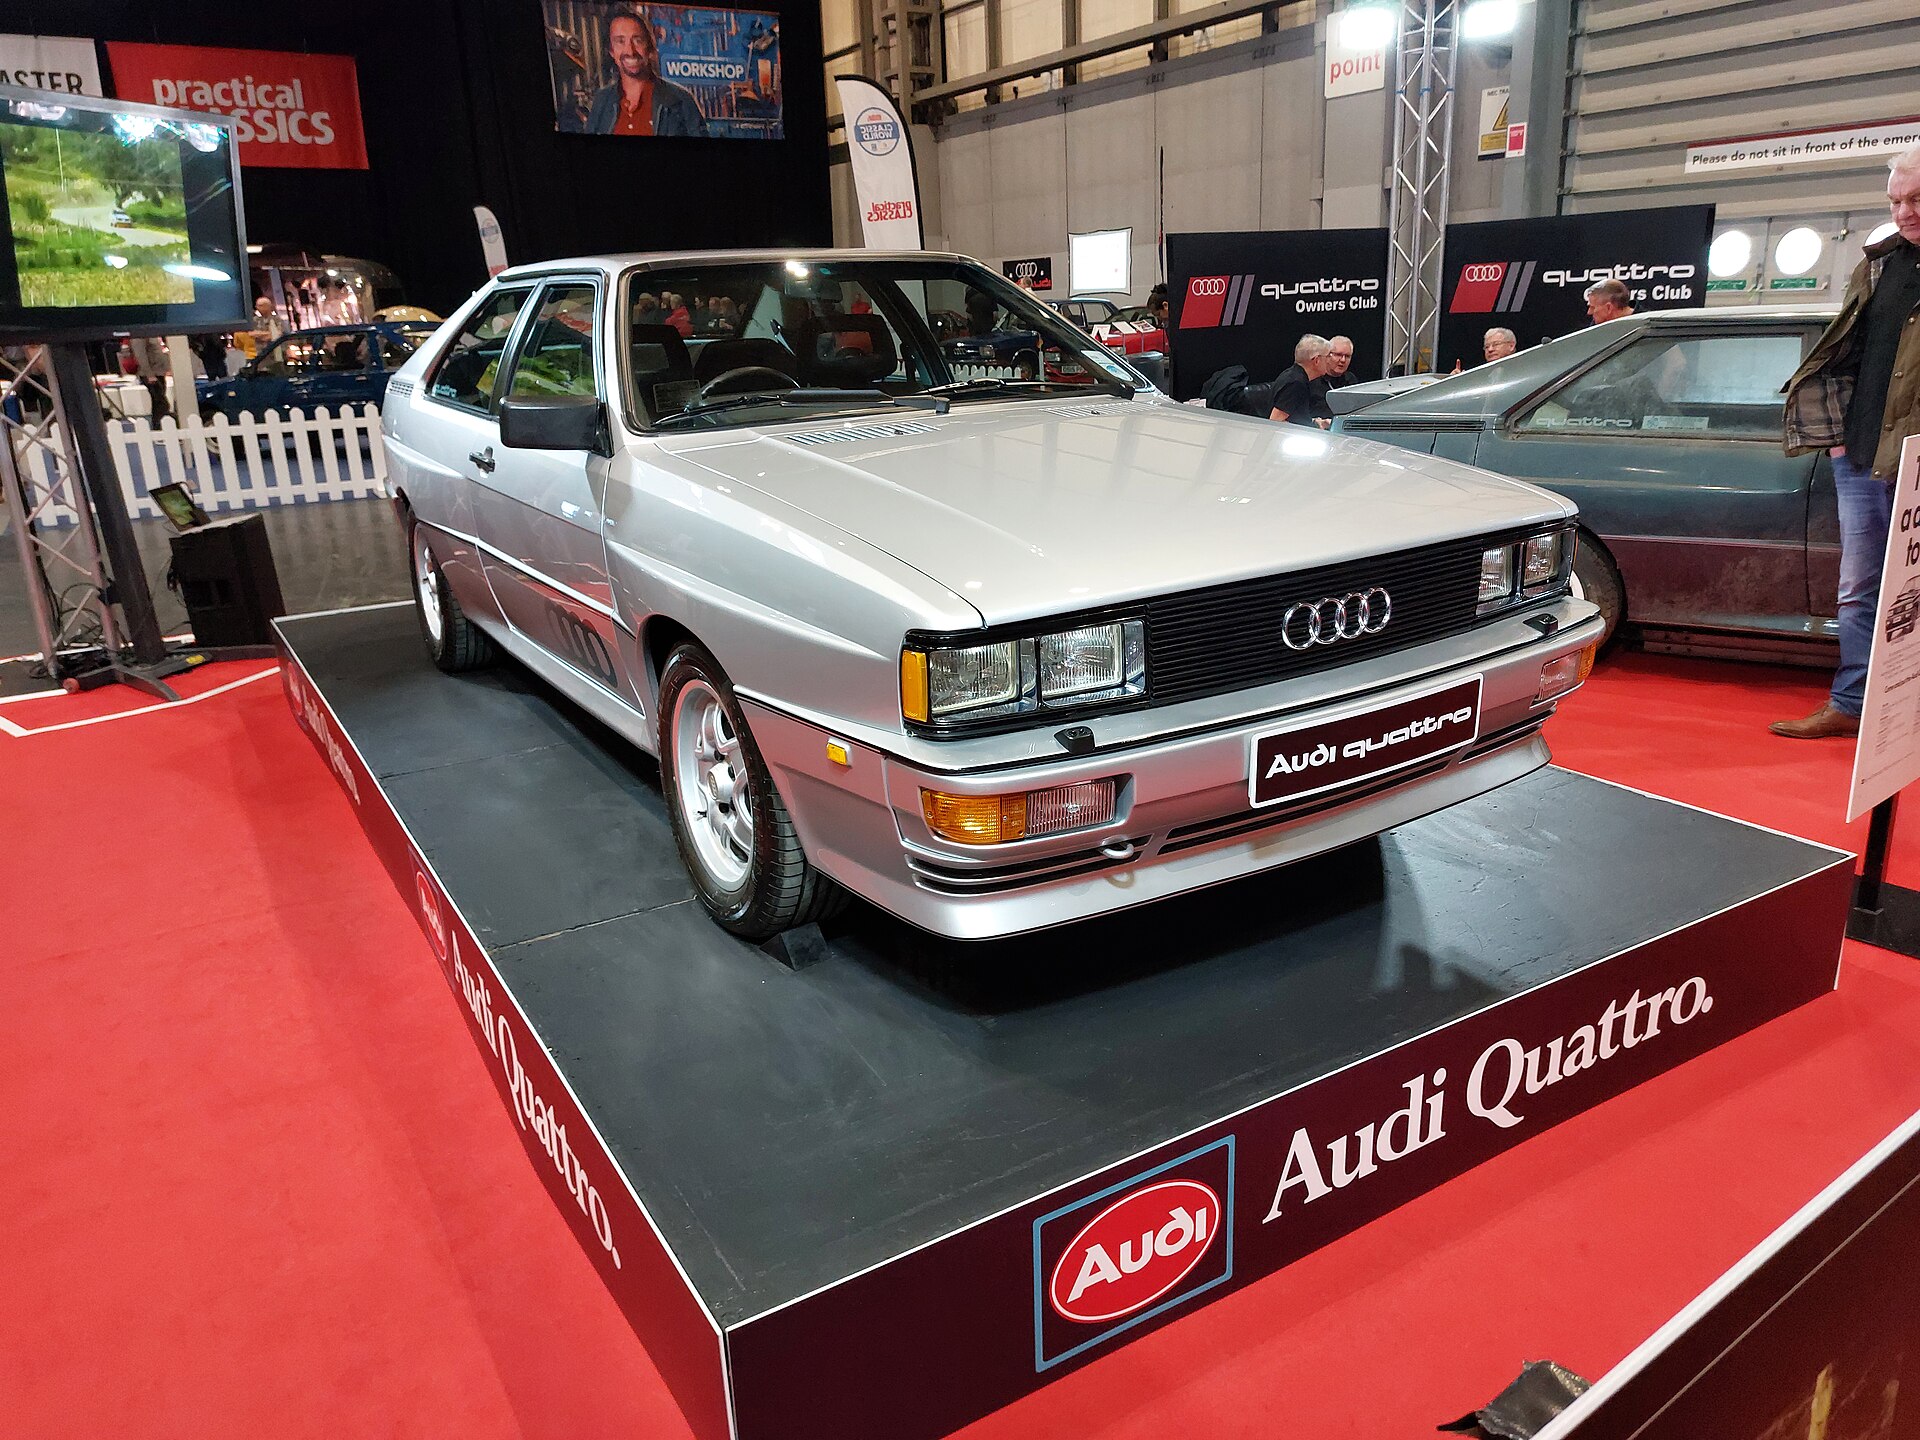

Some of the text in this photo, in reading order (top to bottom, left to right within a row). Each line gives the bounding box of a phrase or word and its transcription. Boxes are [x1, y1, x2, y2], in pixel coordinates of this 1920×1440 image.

[666, 61, 744, 79] WORKSHOP
[1330, 49, 1381, 84] point
[152, 75, 304, 109] practical
[1692, 134, 1920, 165] Please do not sit in front of the emer
[1260, 277, 1379, 300] quattro
[1542, 263, 1695, 287] quattro
[1295, 295, 1378, 313] Owners Club
[1652, 284, 1692, 301] Club
[1535, 416, 1633, 428] quattro
[1265, 706, 1472, 779] Audi quattro
[452, 929, 499, 1059] Audi
[1262, 976, 1713, 1224] Audi Quattro.
[1066, 1206, 1208, 1304] Audi
